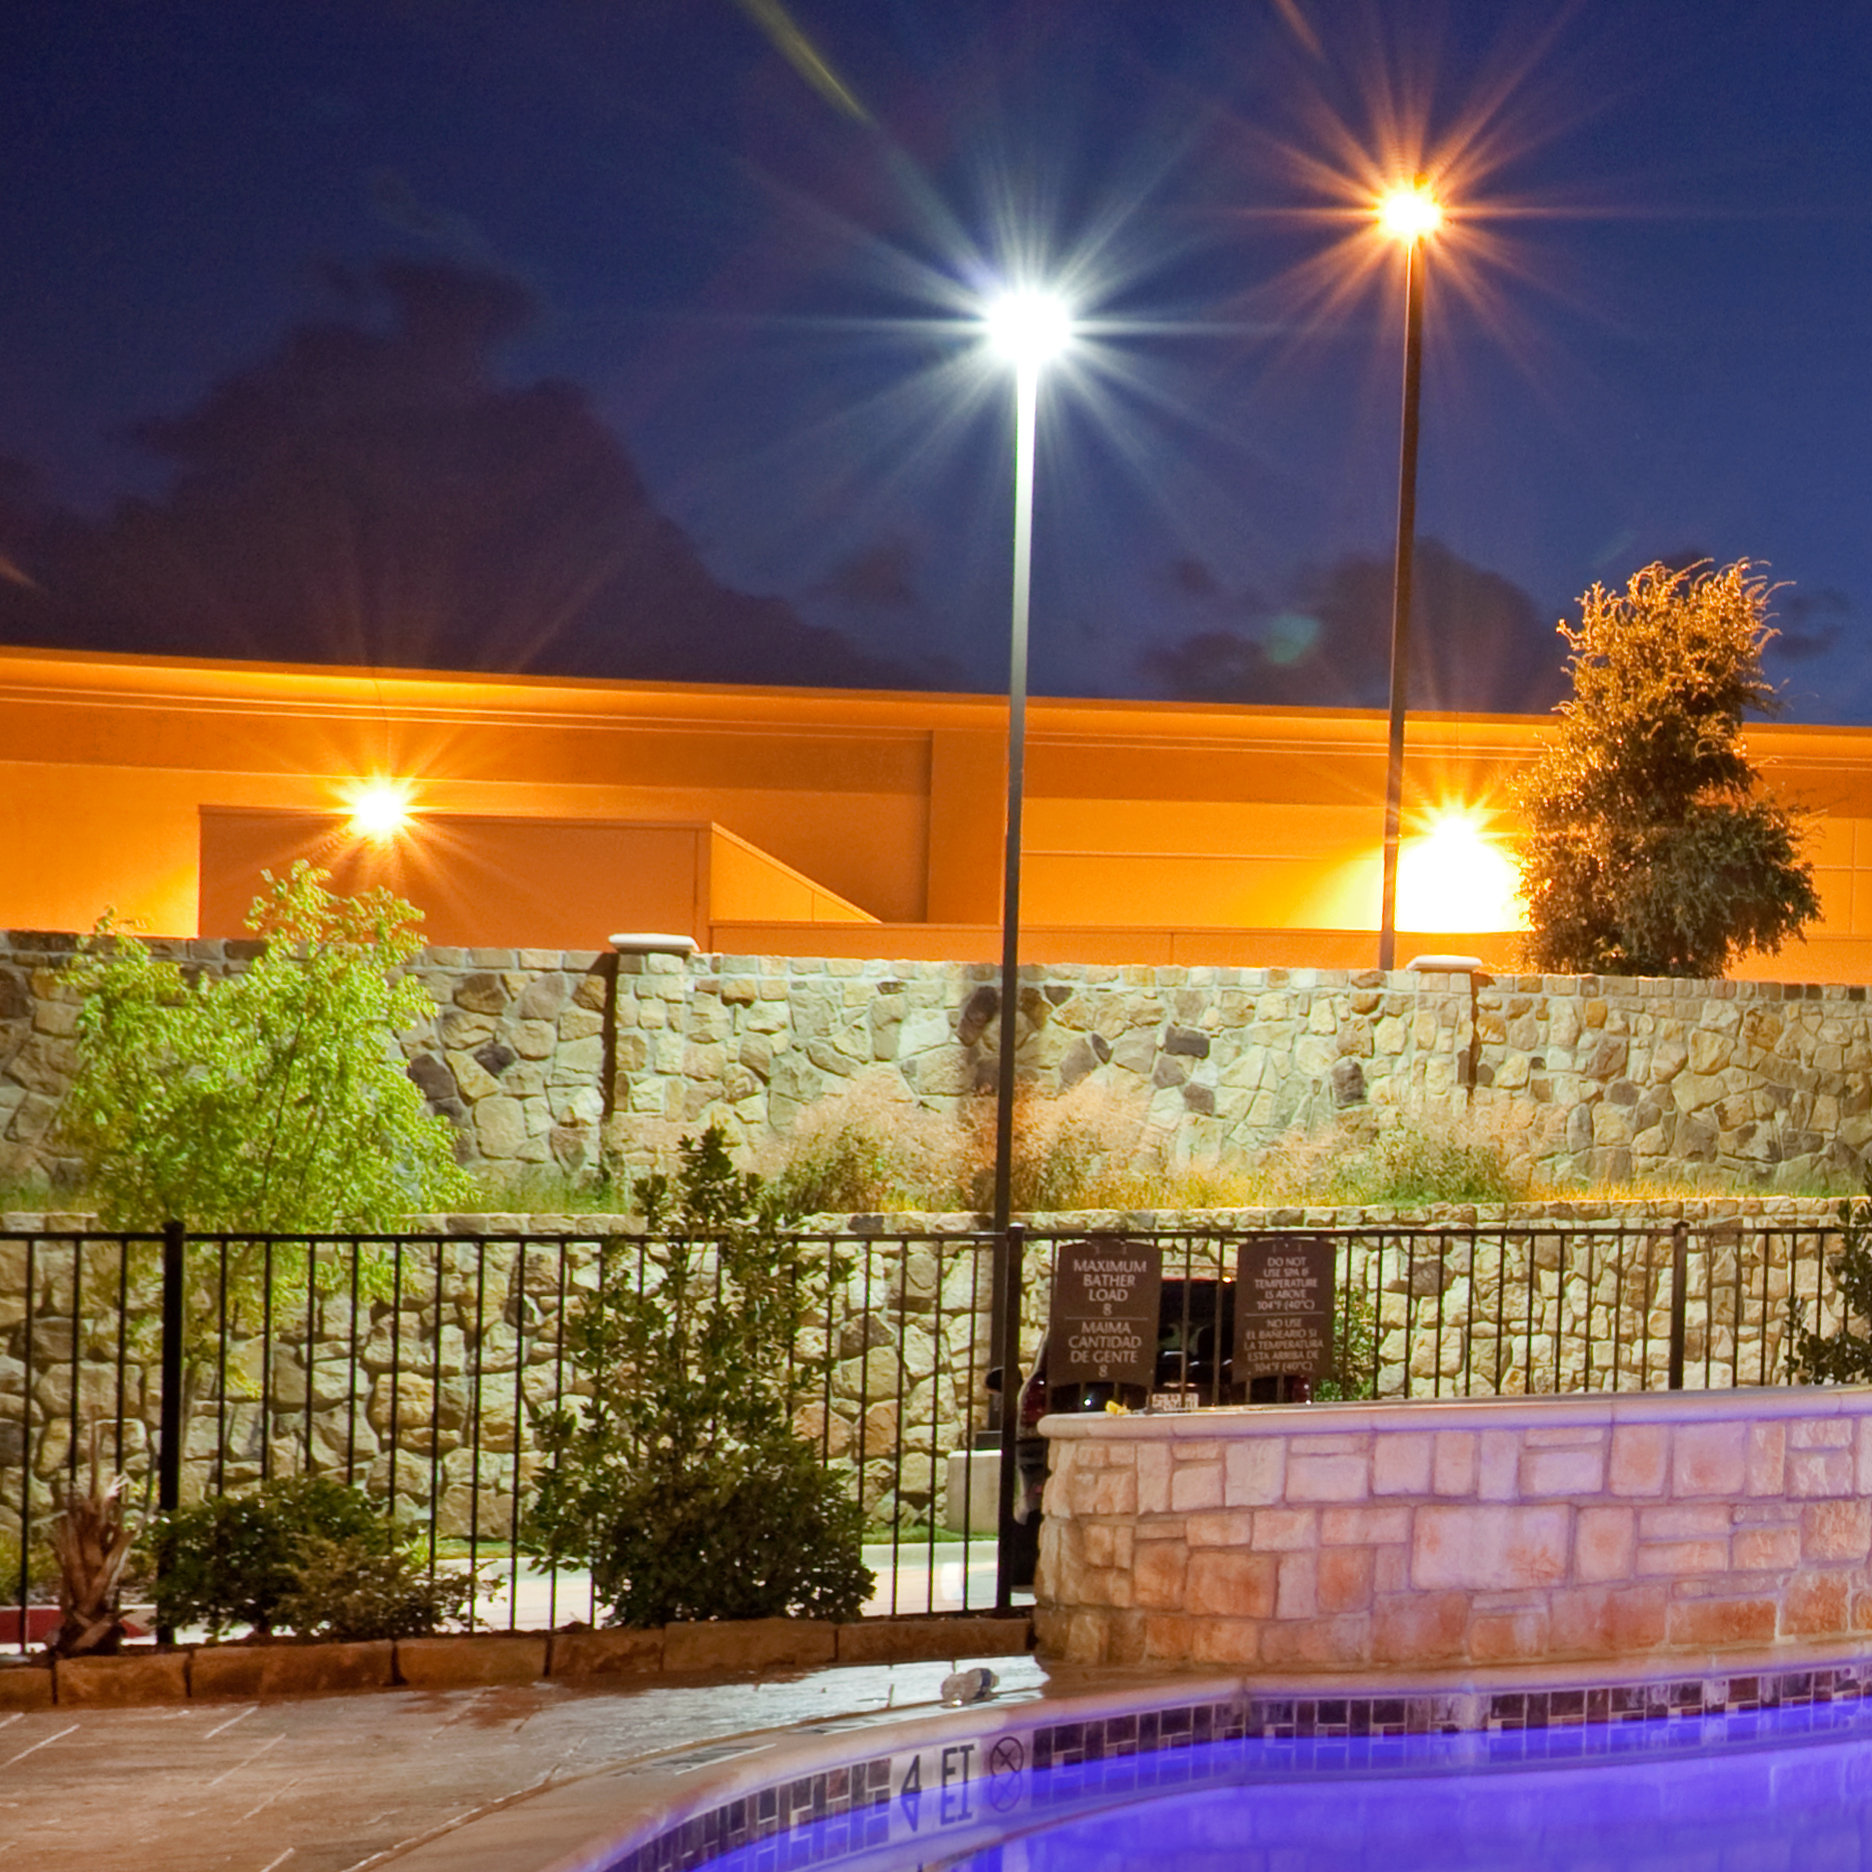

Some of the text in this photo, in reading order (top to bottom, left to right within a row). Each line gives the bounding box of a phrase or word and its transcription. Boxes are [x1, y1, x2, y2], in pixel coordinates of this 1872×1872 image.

[1073, 1259, 1147, 1272] MAXIMUM
[1267, 1256, 1307, 1267] DO NOT
[1083, 1274, 1136, 1287] BATHER
[1255, 1278, 1318, 1289] TEMPERATURE
[1088, 1288, 1129, 1302] LOAD
[1276, 1289, 1306, 1299] ABOVE
[1103, 1303, 1112, 1316] 8
[1081, 1321, 1132, 1334] MAIMA
[1266, 1318, 1283, 1328] NO
[1068, 1335, 1142, 1349] CANTIDAD
[1258, 1339, 1324, 1350] TEMPERATURA
[1070, 1350, 1137, 1363] DE GENTE
[1098, 1364, 1107, 1377] 8
[902, 1744, 975, 1796] 4 FT
